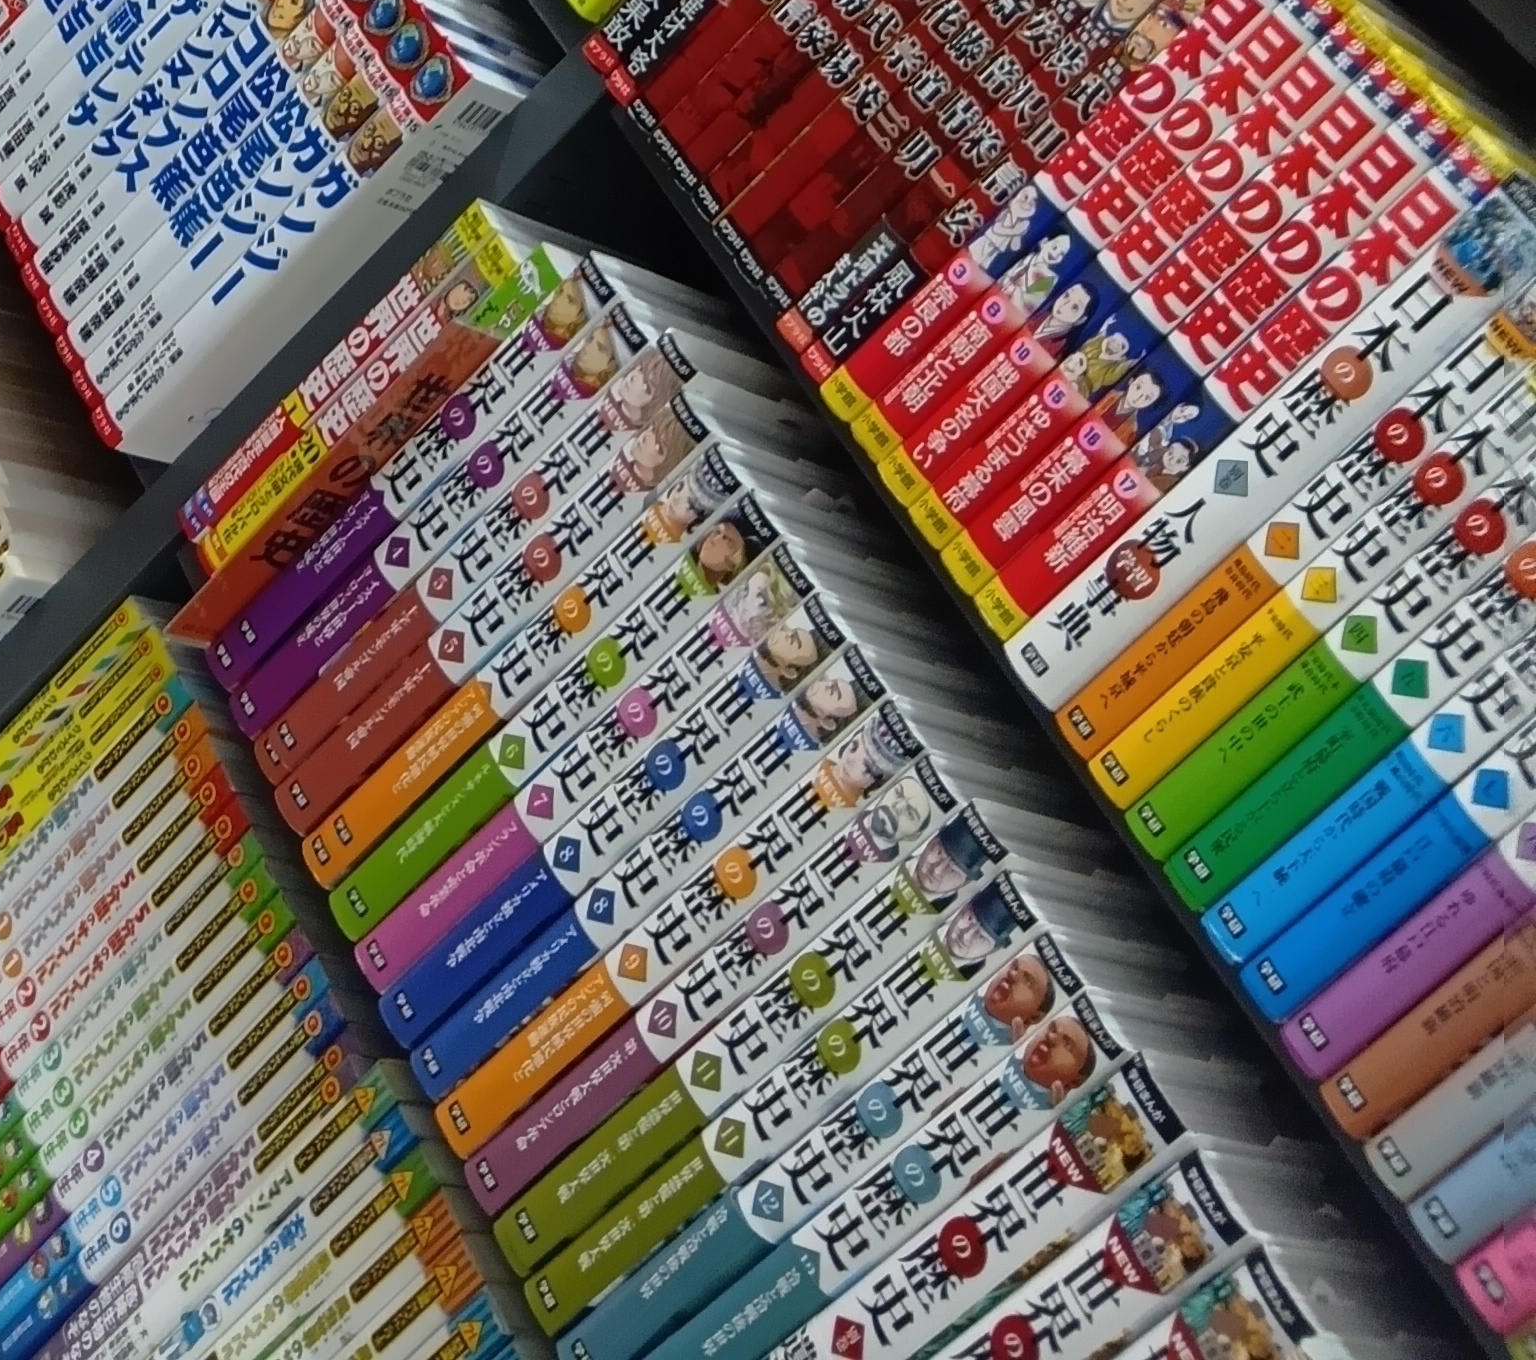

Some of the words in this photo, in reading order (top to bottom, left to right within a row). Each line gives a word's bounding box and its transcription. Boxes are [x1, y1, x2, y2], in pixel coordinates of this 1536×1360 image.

[108, 19, 275, 197] コロンブス
[144, 52, 298, 213] 松尾芭蕉
[160, 87, 319, 249] 松尾芭蕉
[178, 123, 336, 281] ガンジー
[199, 157, 361, 318] ガンジー
